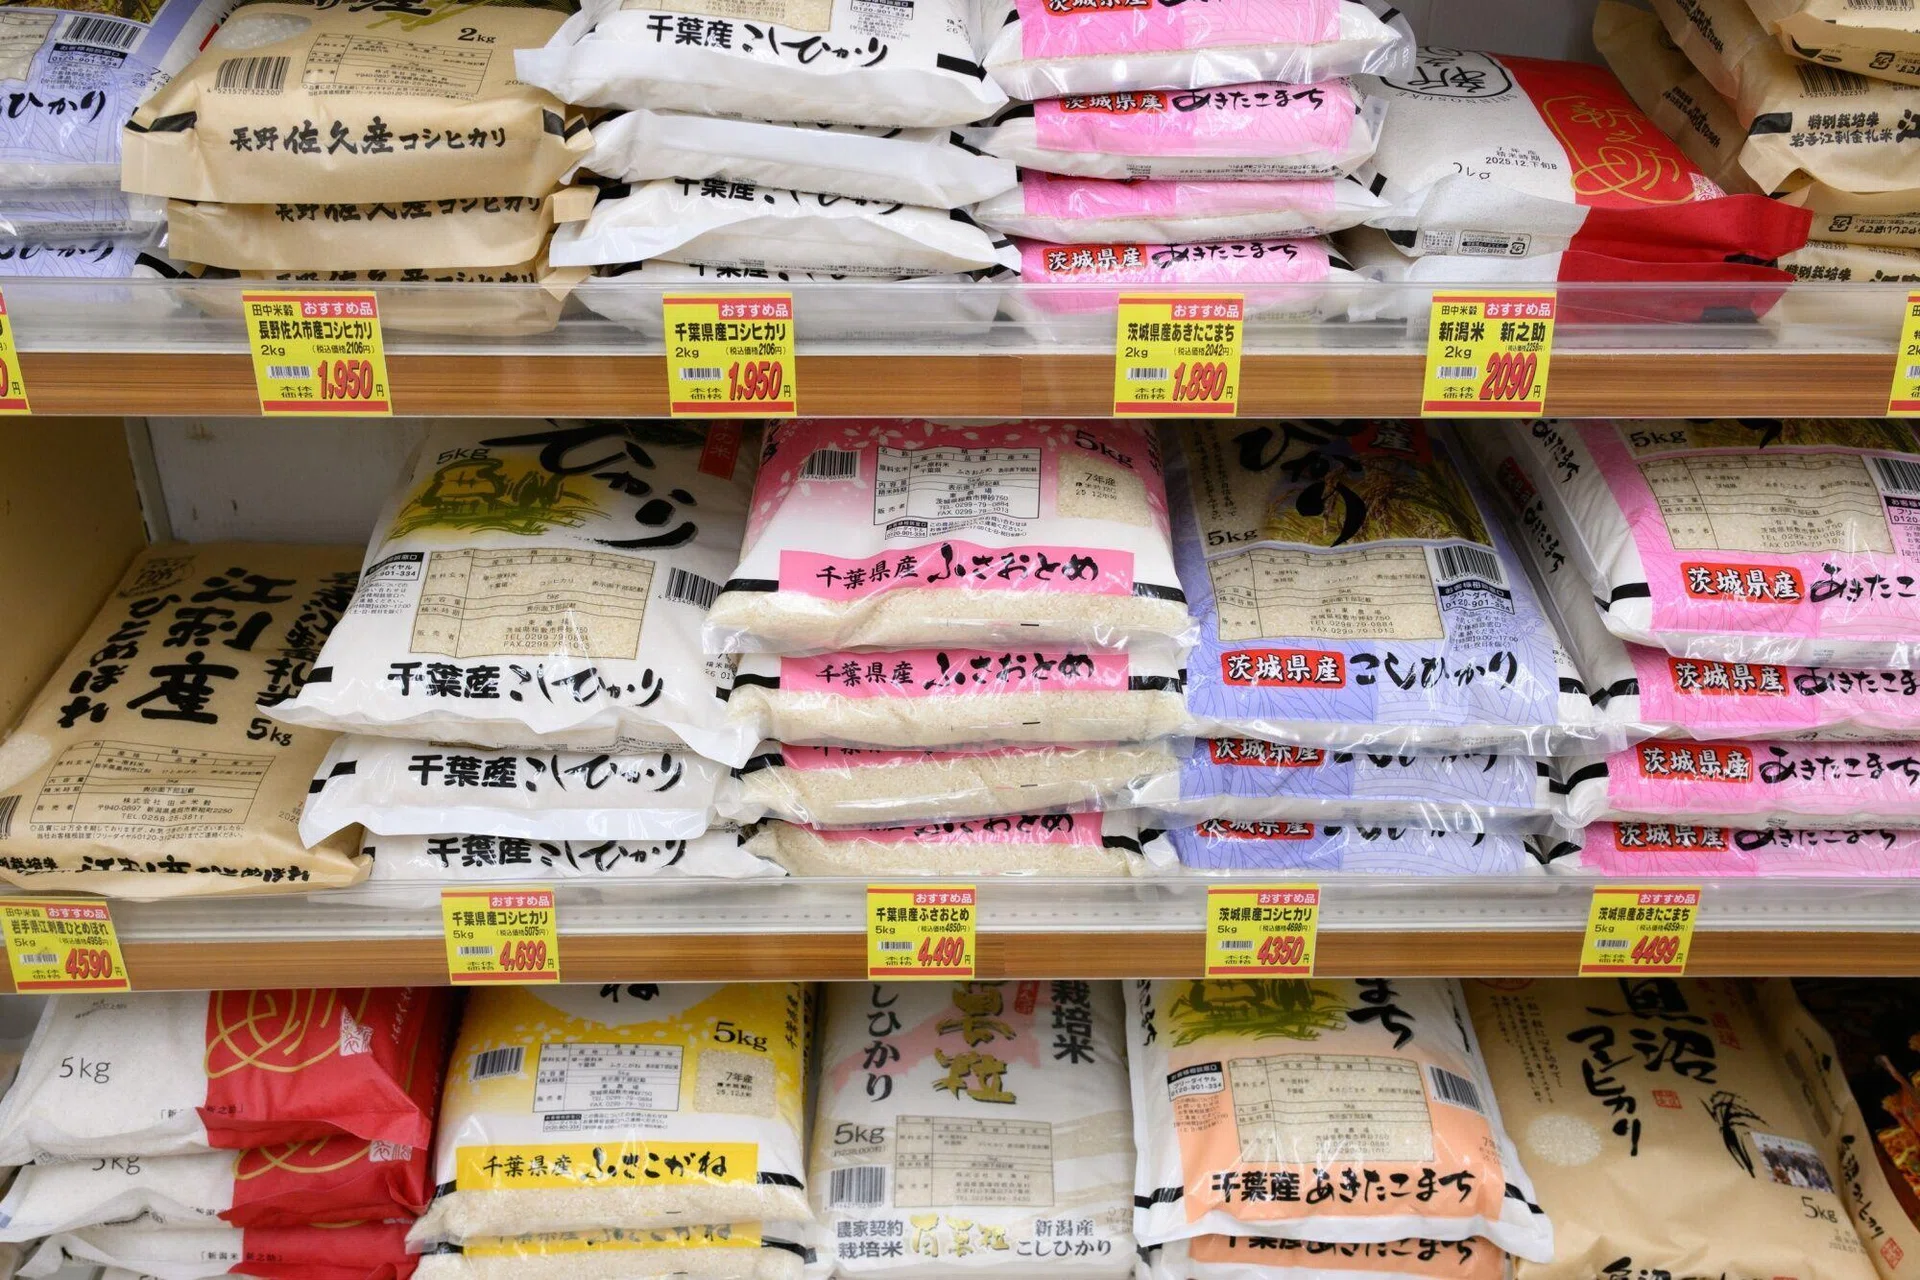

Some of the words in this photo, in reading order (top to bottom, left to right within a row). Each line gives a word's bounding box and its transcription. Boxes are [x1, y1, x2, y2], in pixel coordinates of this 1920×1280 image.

[458, 27, 496, 43] 2kg
[647, 14, 732, 50] 千葉産
[743, 23, 888, 67] こしひかり
[1172, 88, 1325, 112] あきたこまち
[1808, 112, 1879, 130] 特別栽培米
[229, 116, 507, 156] 長野佐久産コシヒカリ
[1047, 245, 1146, 271] 茨城県産
[304, 302, 373, 315] おすすめ品
[721, 304, 788, 317] おすすめ品
[1174, 304, 1239, 318] おすすめ品
[1487, 303, 1550, 316] おすすめ品
[258, 320, 373, 340] 長野佐久市産コシヒカリ
[675, 322, 786, 342] 千葉県産コシヒカリ
[1127, 323, 1235, 342] 茨城県産あきたこまち
[1438, 322, 1485, 342] 新潟米
[1500, 322, 1545, 342] 新之助
[261, 345, 286, 356] 2kg
[675, 347, 699, 358] 2kg
[1125, 347, 1148, 358] 2kg
[1444, 346, 1472, 359] 2kg
[1631, 429, 1688, 448] 5kg
[436, 446, 491, 465] 5kg
[1074, 430, 1134, 469] 5kg
[1207, 530, 1258, 547] 5kg
[816, 554, 917, 590] 千葉県産
[927, 543, 1099, 583] ふさおとめ
[1688, 568, 1801, 600] 茨城県産
[816, 661, 914, 687] 千葉県産
[925, 653, 1095, 691] ふさおとめ
[1227, 653, 1342, 684] 茨城県産
[1349, 650, 1517, 691] こしひかり
[1676, 664, 1786, 692] 茨城県産
[387, 661, 500, 700] 千葉産
[509, 663, 664, 708] こしひかり
[246, 717, 293, 746] 5kg
[407, 753, 518, 789] 千葉産
[525, 752, 683, 793] こしひかり
[1643, 748, 1750, 779] 茨城県産
[1619, 823, 1726, 849] 茨城県産
[426, 837, 532, 867] 千葉産
[492, 896, 550, 907] おすすめ品
[916, 893, 972, 904] おすすめ品
[1260, 893, 1315, 904] おすすめ品
[1640, 893, 1696, 904] おすすめ品
[48, 908, 106, 919] おすすめ品
[452, 911, 548, 926] 千葉県産コシヒカリ
[876, 907, 970, 922] 千葉県産ふさおとめ
[1219, 907, 1312, 921] 茨城県産コシヒカリ
[1598, 907, 1690, 921] 茨城県産あきたこまち
[453, 930, 474, 939] 5kg
[875, 926, 896, 934] 5kg
[1217, 925, 1237, 934] 5kg
[1594, 924, 1615, 933] 5kg
[14, 938, 36, 947] 5kg
[713, 1021, 768, 1052] 5kg
[59, 1057, 111, 1084] 5kg
[726, 1072, 753, 1083] 7年産
[833, 1123, 885, 1146] 5kg
[482, 1155, 572, 1178] 千葉県産
[581, 1147, 727, 1179] ふさこがね
[1212, 1172, 1300, 1203] 千葉産
[1306, 1169, 1477, 1204] あきたこまち
[1801, 1196, 1839, 1224] 5kg
[837, 1220, 903, 1237] 農家契約
[1035, 1218, 1095, 1237] 新潟産
[838, 1240, 904, 1260] 栽培米
[1016, 1239, 1112, 1258] こしひかり
